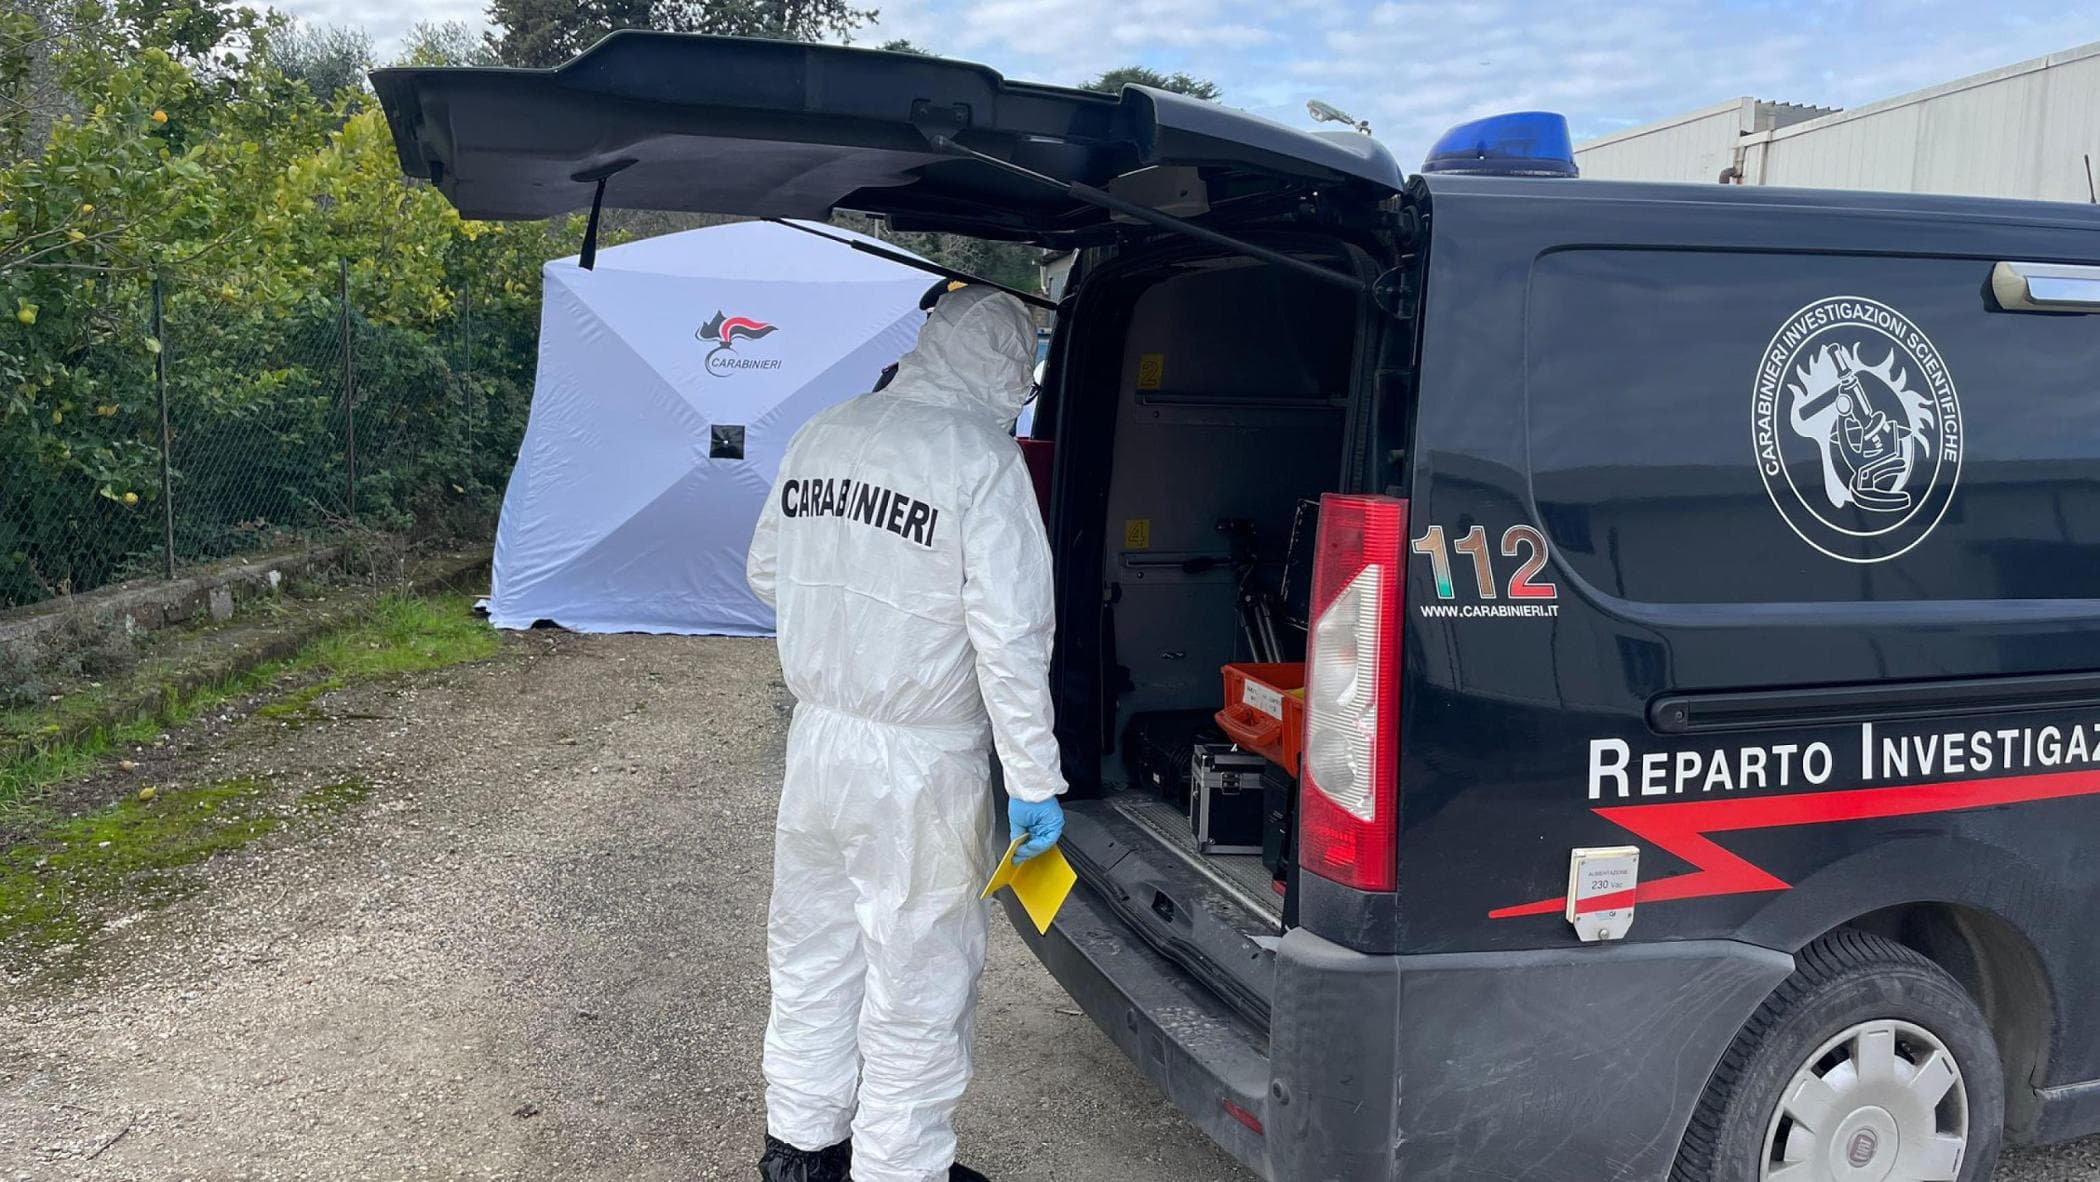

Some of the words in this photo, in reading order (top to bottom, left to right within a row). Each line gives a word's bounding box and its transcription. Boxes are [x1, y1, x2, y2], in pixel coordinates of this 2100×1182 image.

[711, 357, 782, 370] CARABINIERI
[1757, 343, 1788, 477] CARABINIERI
[1783, 302, 1908, 349] INVESTIGAZIONI
[1906, 332, 1958, 463] SCIENTIFICHE
[781, 478, 939, 548] CARABINIERI
[1411, 524, 1558, 599] 112
[1420, 605, 1559, 618] WWW.CARABINIERI.IT
[1588, 738, 1833, 800] REPARTO
[1591, 880, 1609, 890] 230
